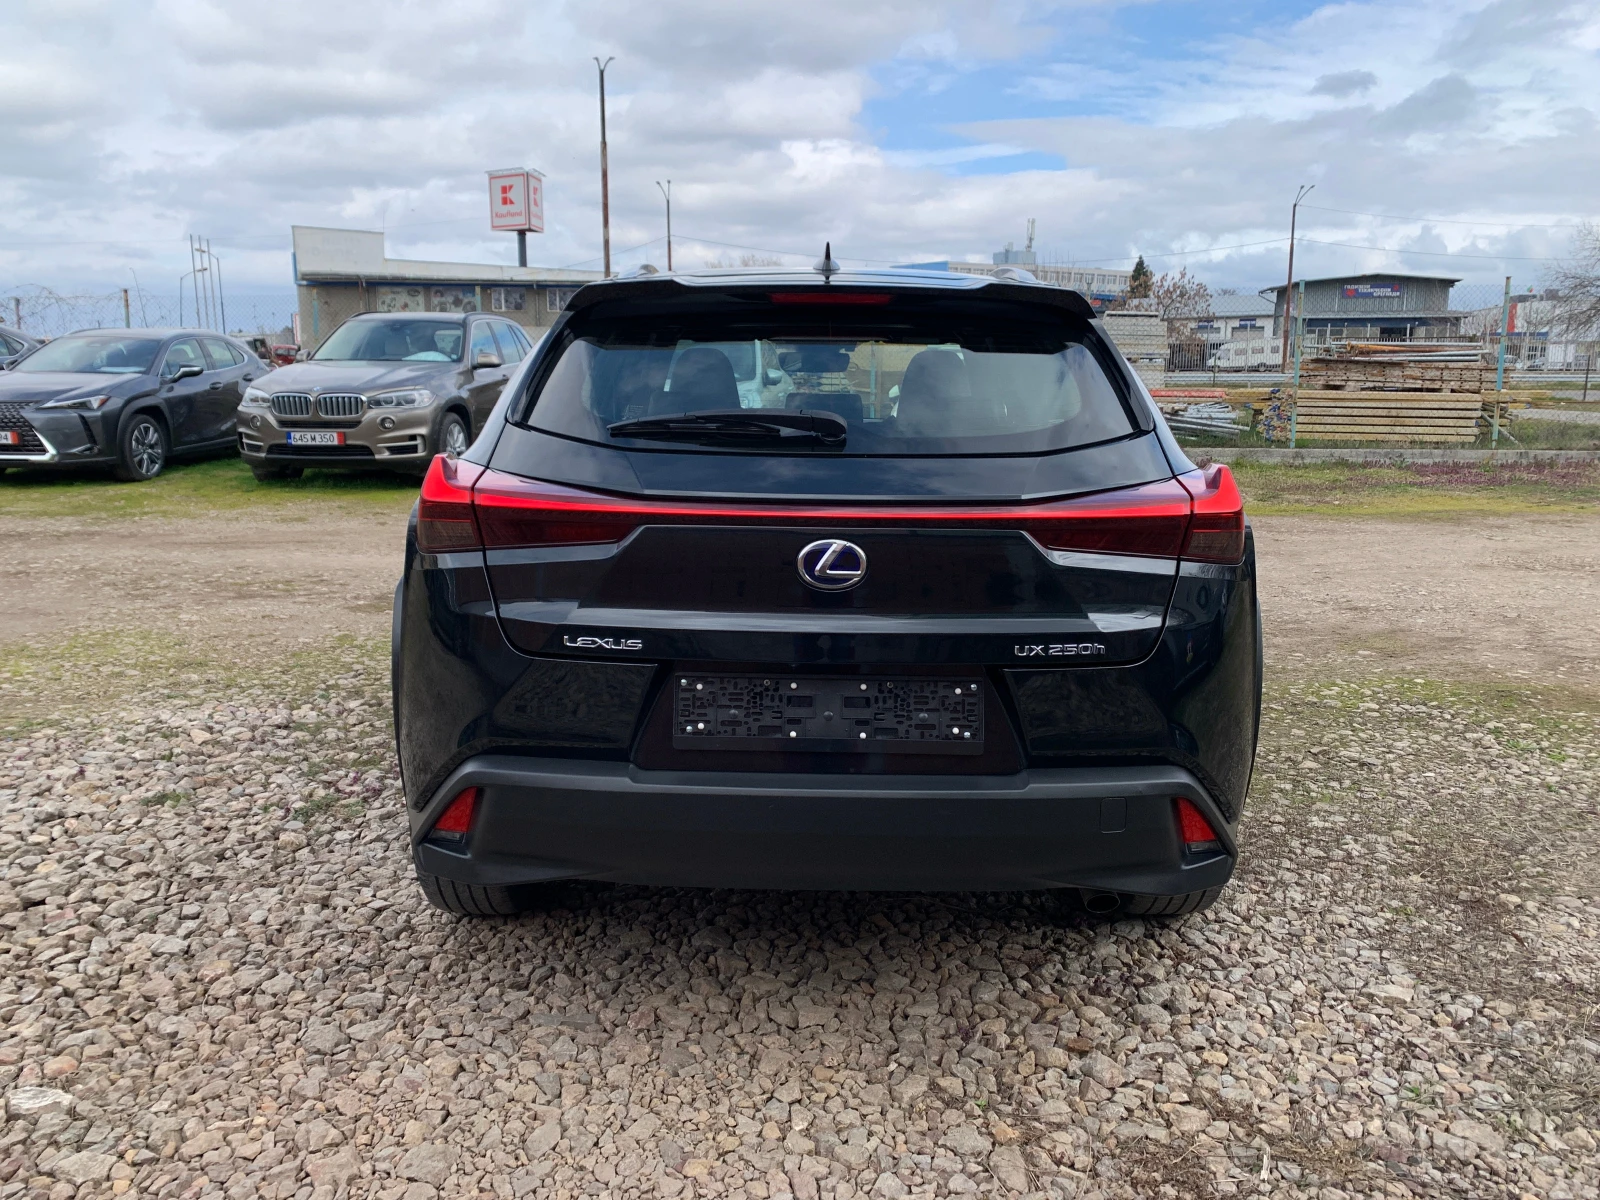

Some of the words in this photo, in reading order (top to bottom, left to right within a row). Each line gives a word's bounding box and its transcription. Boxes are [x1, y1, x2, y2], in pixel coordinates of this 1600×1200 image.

[501, 184, 515, 206] K
[495, 210, 523, 219] Kaufland
[292, 433, 309, 443] 645
[318, 433, 335, 443] 350
[563, 635, 643, 650] LEXUS
[1014, 645, 1046, 656] UX
[1048, 643, 1106, 656] 250h
